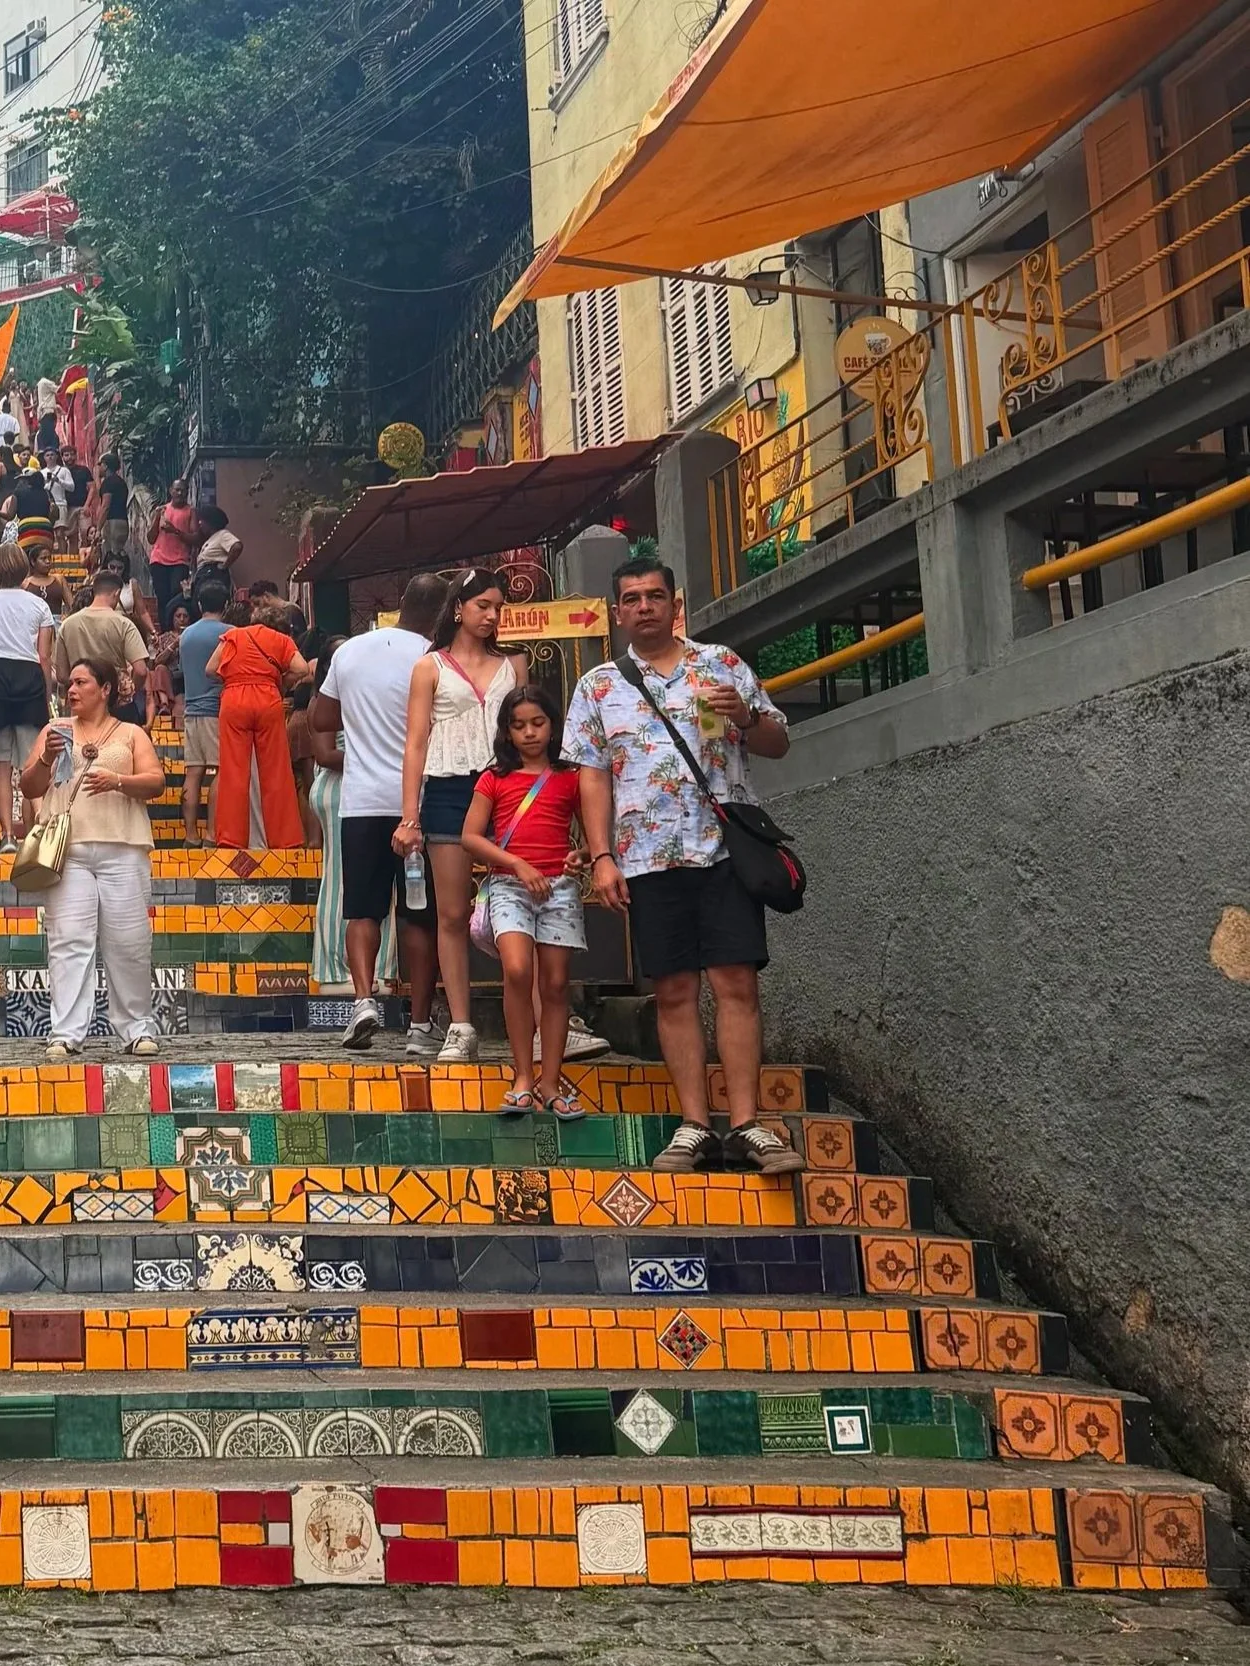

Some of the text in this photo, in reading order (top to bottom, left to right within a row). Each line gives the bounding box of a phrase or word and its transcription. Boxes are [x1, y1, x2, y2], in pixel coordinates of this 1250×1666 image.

[843, 355, 869, 369] CAFÉ
[736, 408, 765, 447] RIO
[498, 607, 550, 629] LARÓN
